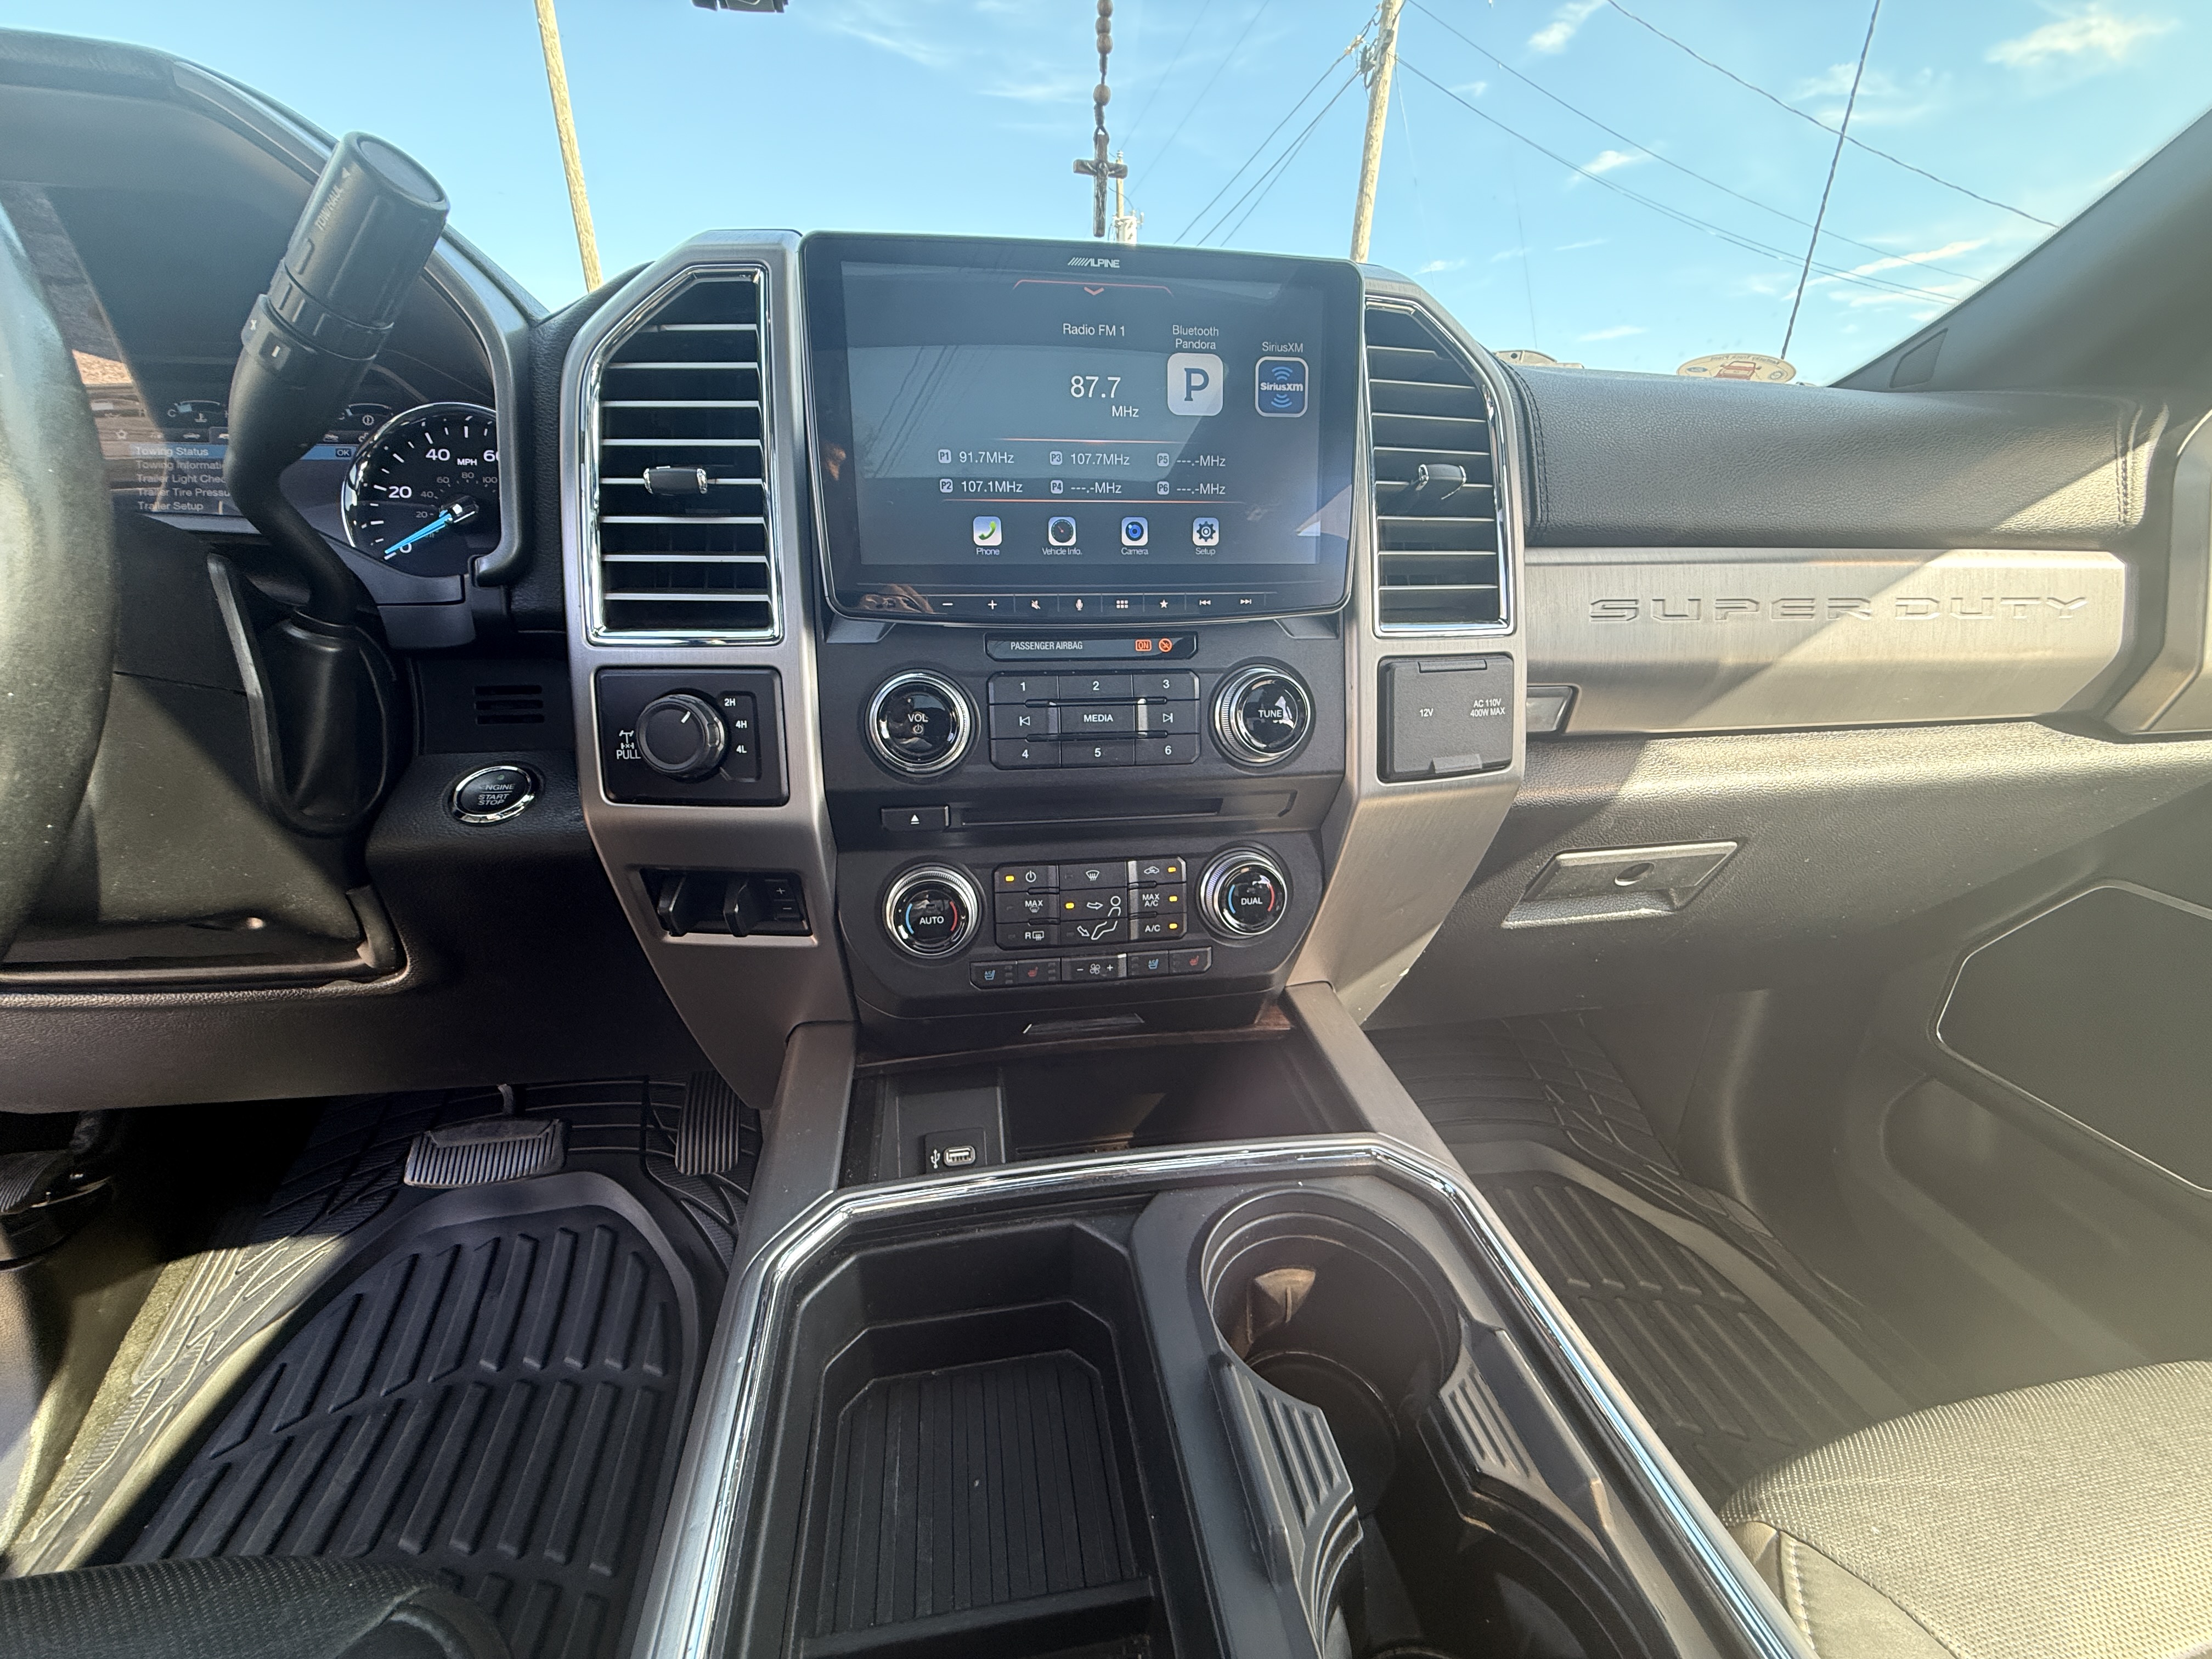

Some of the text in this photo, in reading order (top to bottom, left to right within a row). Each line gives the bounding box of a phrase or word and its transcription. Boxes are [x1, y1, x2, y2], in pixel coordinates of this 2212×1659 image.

[1084, 257, 1120, 268] ALPINE
[1063, 323, 1125, 336] Radio FM 1
[1172, 325, 1219, 337] Bluetooth
[1175, 338, 1216, 350] Pandora
[1262, 342, 1304, 353] SiriusXM
[1070, 376, 1121, 398] 87.7
[1111, 406, 1139, 417] MHz
[137, 446, 209, 456] Towing Status
[425, 449, 450, 461] 40
[483, 450, 499, 462] 6
[457, 458, 477, 466] MPH
[940, 452, 1014, 464] P1 91.7MHz
[1051, 453, 1130, 466] P3 107.7MHz
[1158, 455, 1169, 464] P5
[137, 460, 174, 470] Towing
[137, 473, 168, 483] Trailer
[172, 475, 198, 484] Light
[941, 481, 1023, 493] P2 107.1MHz
[1052, 482, 1062, 492] P4
[1158, 483, 1169, 493] P6
[138, 488, 230, 497] Trailer Tire Pressu
[388, 486, 412, 499] 20
[138, 501, 204, 512] Trailer Setup
[976, 548, 1000, 556] Phone
[1042, 547, 1083, 555] Vehicle Info.
[1121, 548, 1149, 556] Camera
[1195, 548, 1216, 556] Setup
[1590, 597, 2088, 622] SUPER DUTY
[1011, 641, 1083, 650] PASSENGER AIRBAG
[1137, 641, 1149, 650] ON
[1020, 682, 1026, 691] 1
[1093, 681, 1100, 691] 2
[1163, 679, 1170, 689] 3
[724, 698, 736, 707] 2H
[1473, 698, 1502, 708] AC 110V
[1257, 709, 1283, 718] TUNE
[1419, 708, 1434, 718] 12V
[1470, 707, 1506, 718] 400W MAX
[907, 713, 929, 723] VOL
[1084, 714, 1114, 723] MEDIA
[735, 720, 748, 729] 4H
[736, 744, 748, 754] 4L
[1022, 749, 1029, 759] 4
[1094, 748, 1102, 758] 5
[1165, 746, 1172, 755] 6
[616, 749, 641, 760] PULL
[1240, 896, 1263, 906] DUAL
[919, 915, 945, 925] AUTO
[1144, 924, 1161, 933] A/C
[1025, 932, 1032, 940] R
